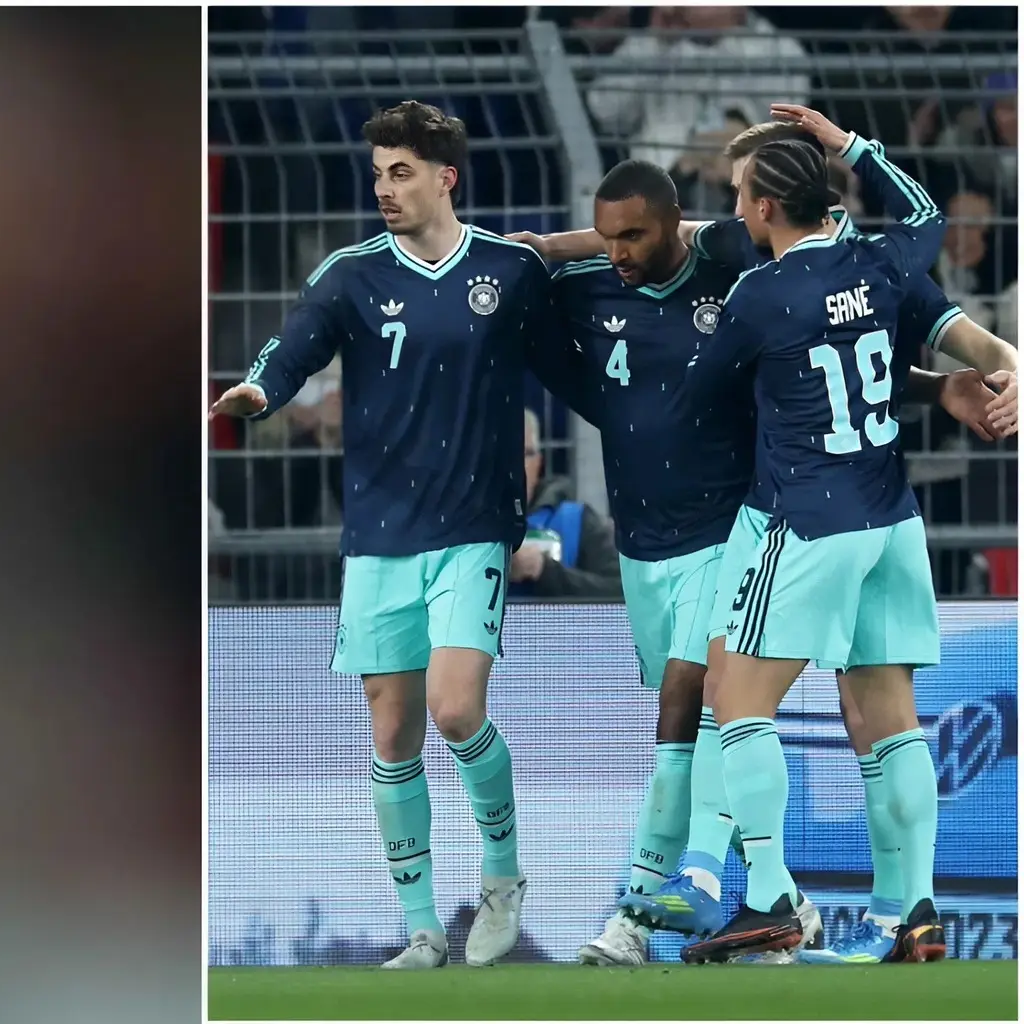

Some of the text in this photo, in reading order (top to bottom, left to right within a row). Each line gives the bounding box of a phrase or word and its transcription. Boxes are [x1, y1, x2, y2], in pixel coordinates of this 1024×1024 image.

[825, 278, 874, 326] SANÉ
[381, 321, 407, 369] 7
[605, 339, 630, 386] 4
[808, 329, 899, 454] 19
[484, 567, 502, 611] 7
[388, 836, 416, 852] DFB
[639, 847, 664, 865] DFB
